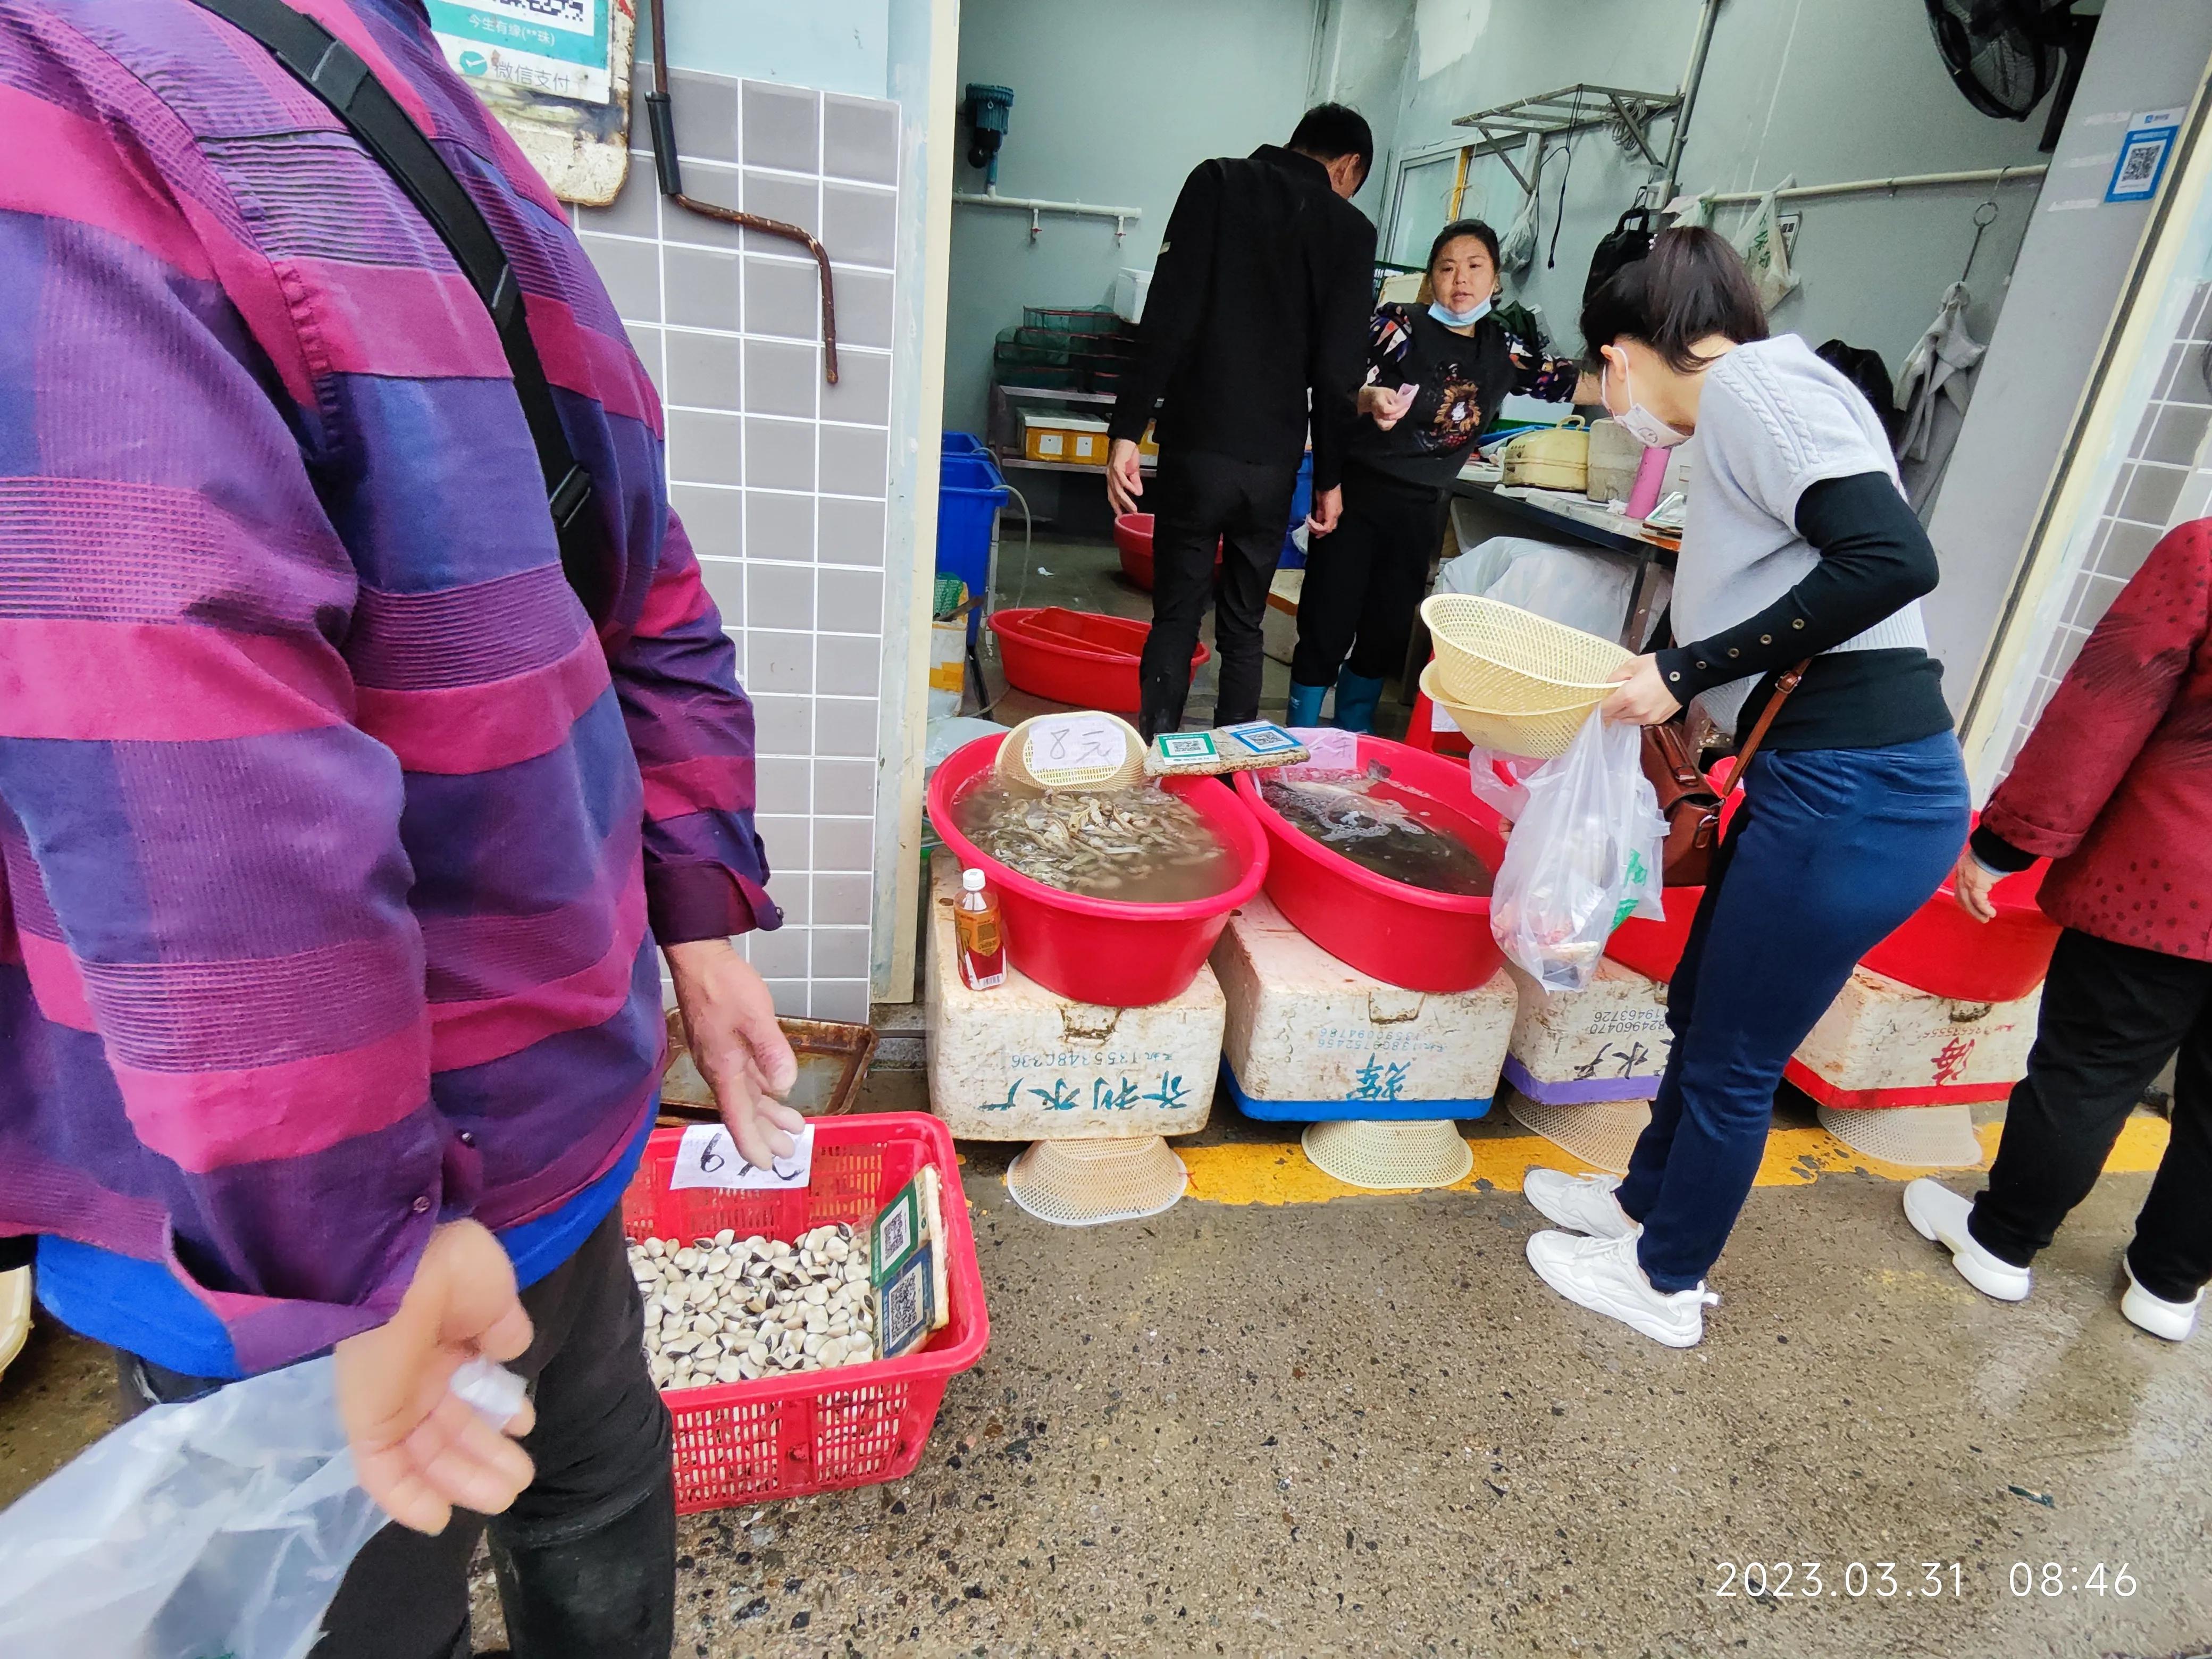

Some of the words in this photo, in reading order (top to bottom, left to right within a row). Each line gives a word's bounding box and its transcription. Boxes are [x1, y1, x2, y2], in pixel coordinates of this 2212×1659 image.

[495, 60, 571, 93] 微信支付
[1589, 1019, 1671, 1034] 824960470
